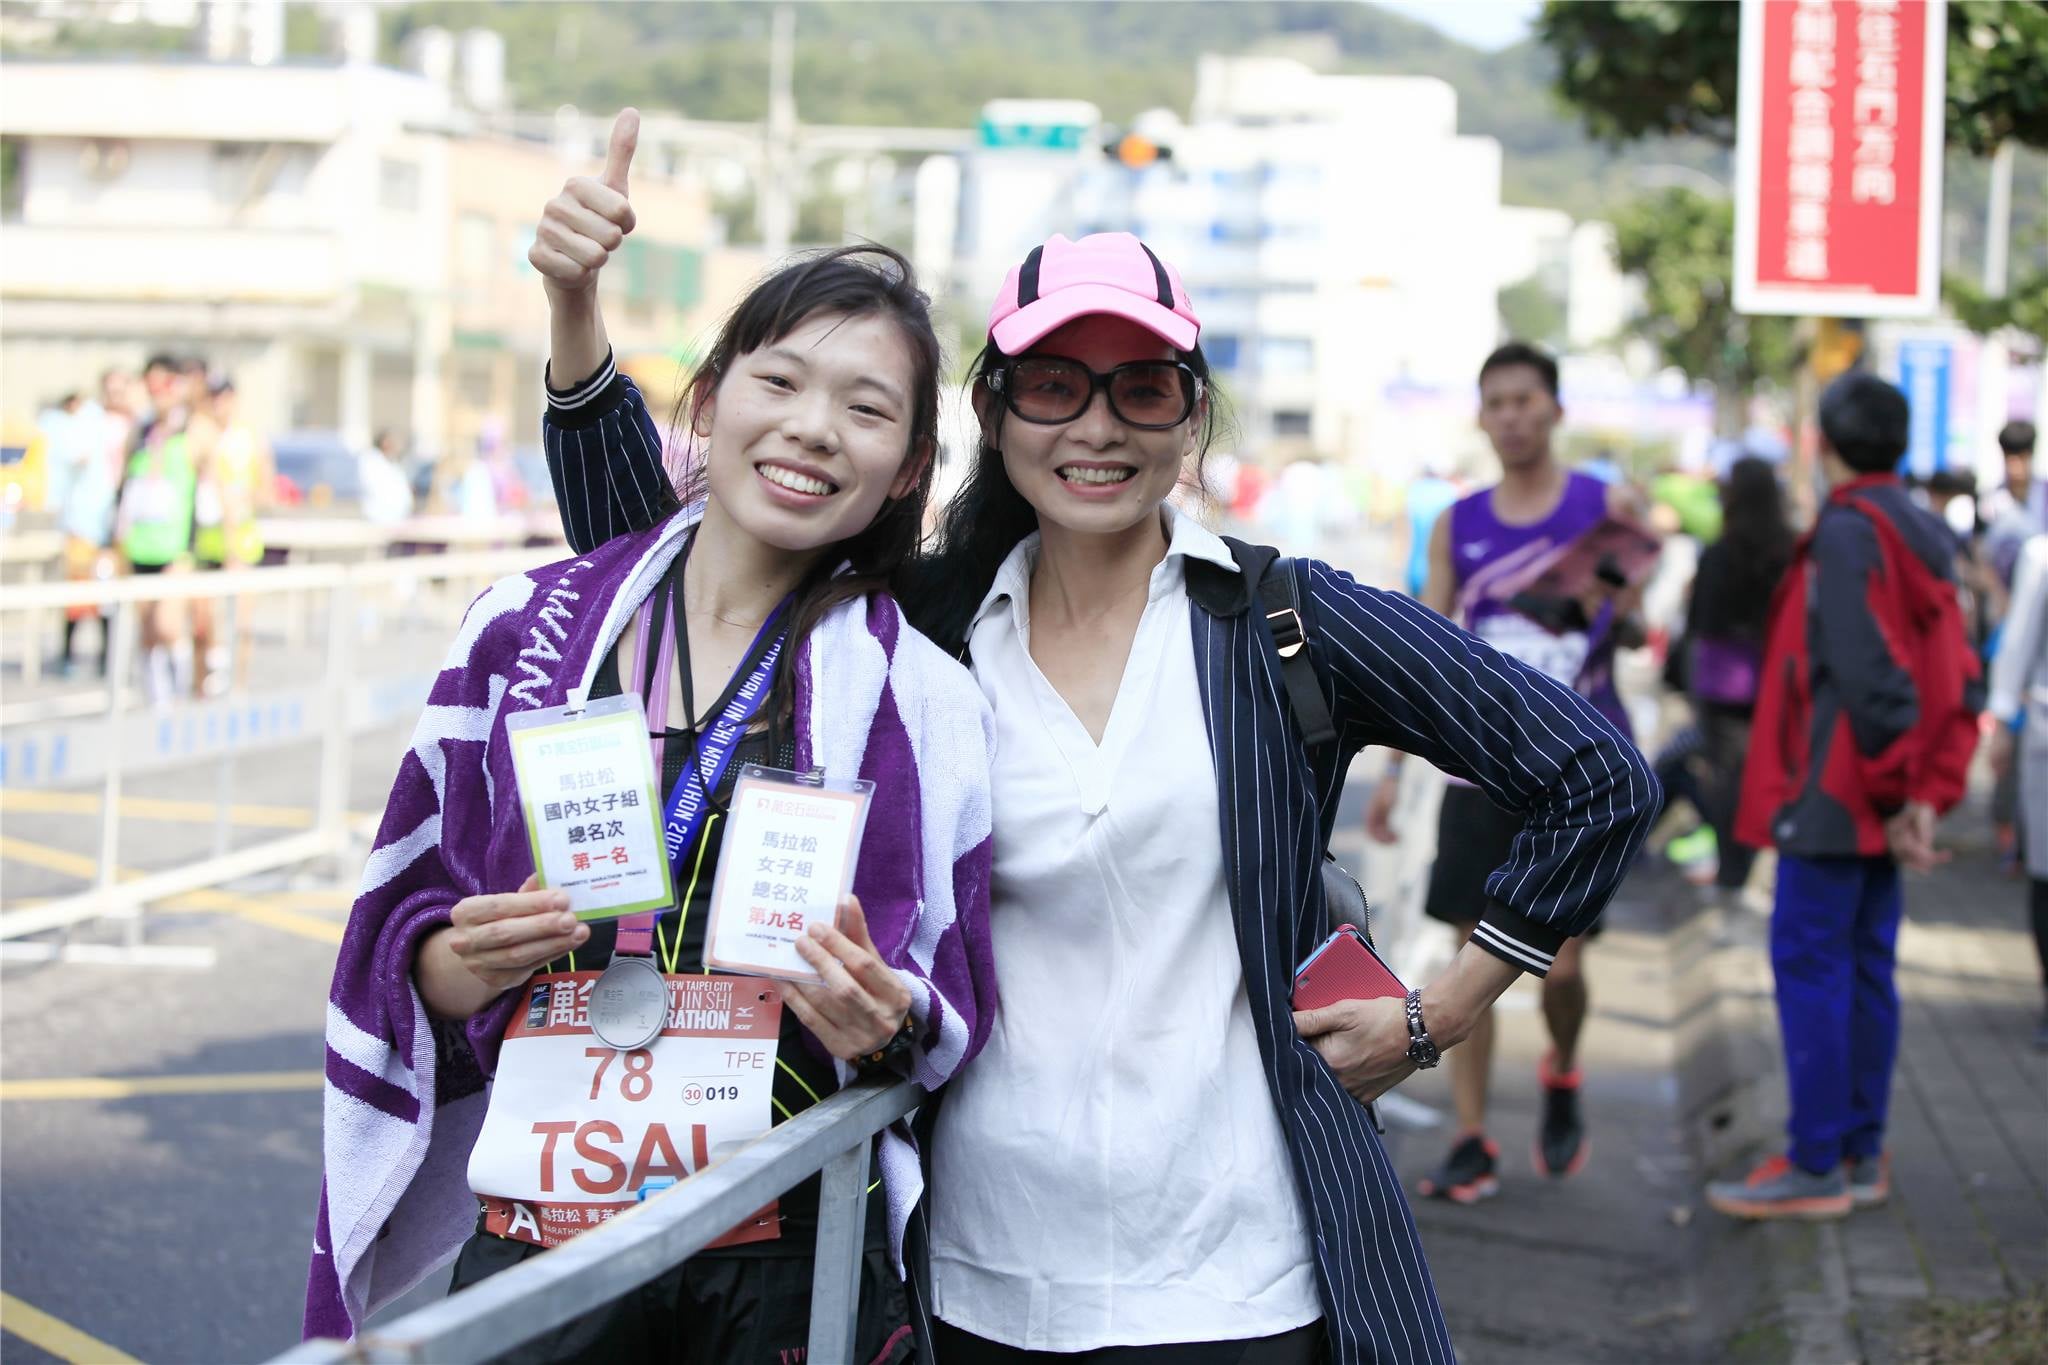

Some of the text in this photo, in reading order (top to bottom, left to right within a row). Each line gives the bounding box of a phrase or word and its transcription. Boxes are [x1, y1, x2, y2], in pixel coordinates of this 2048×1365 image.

[509, 588, 580, 708] WAN
[737, 671, 766, 700] WAN
[722, 700, 748, 721] JIN
[710, 720, 737, 745] SHI
[559, 767, 615, 791] 馬拉松
[544, 789, 640, 821] 國內女子組
[568, 819, 625, 844] 總名次
[762, 831, 818, 853] 馬拉松
[572, 846, 628, 871] 第一名
[757, 856, 814, 879] 女子組
[752, 880, 809, 904] 總名次
[748, 906, 804, 931] 第九名
[666, 981, 734, 992] NEW TAIPEI CITY
[679, 991, 702, 1009] JIN
[706, 992, 732, 1010] SHI
[664, 1009, 730, 1030] RATHON
[724, 1051, 766, 1069] TPE
[585, 1046, 654, 1102] 78
[685, 1086, 738, 1100] 30 019
[531, 1119, 709, 1195] TSAI
[508, 1202, 542, 1242] A
[541, 1206, 625, 1223] 馬拉松 菁英
